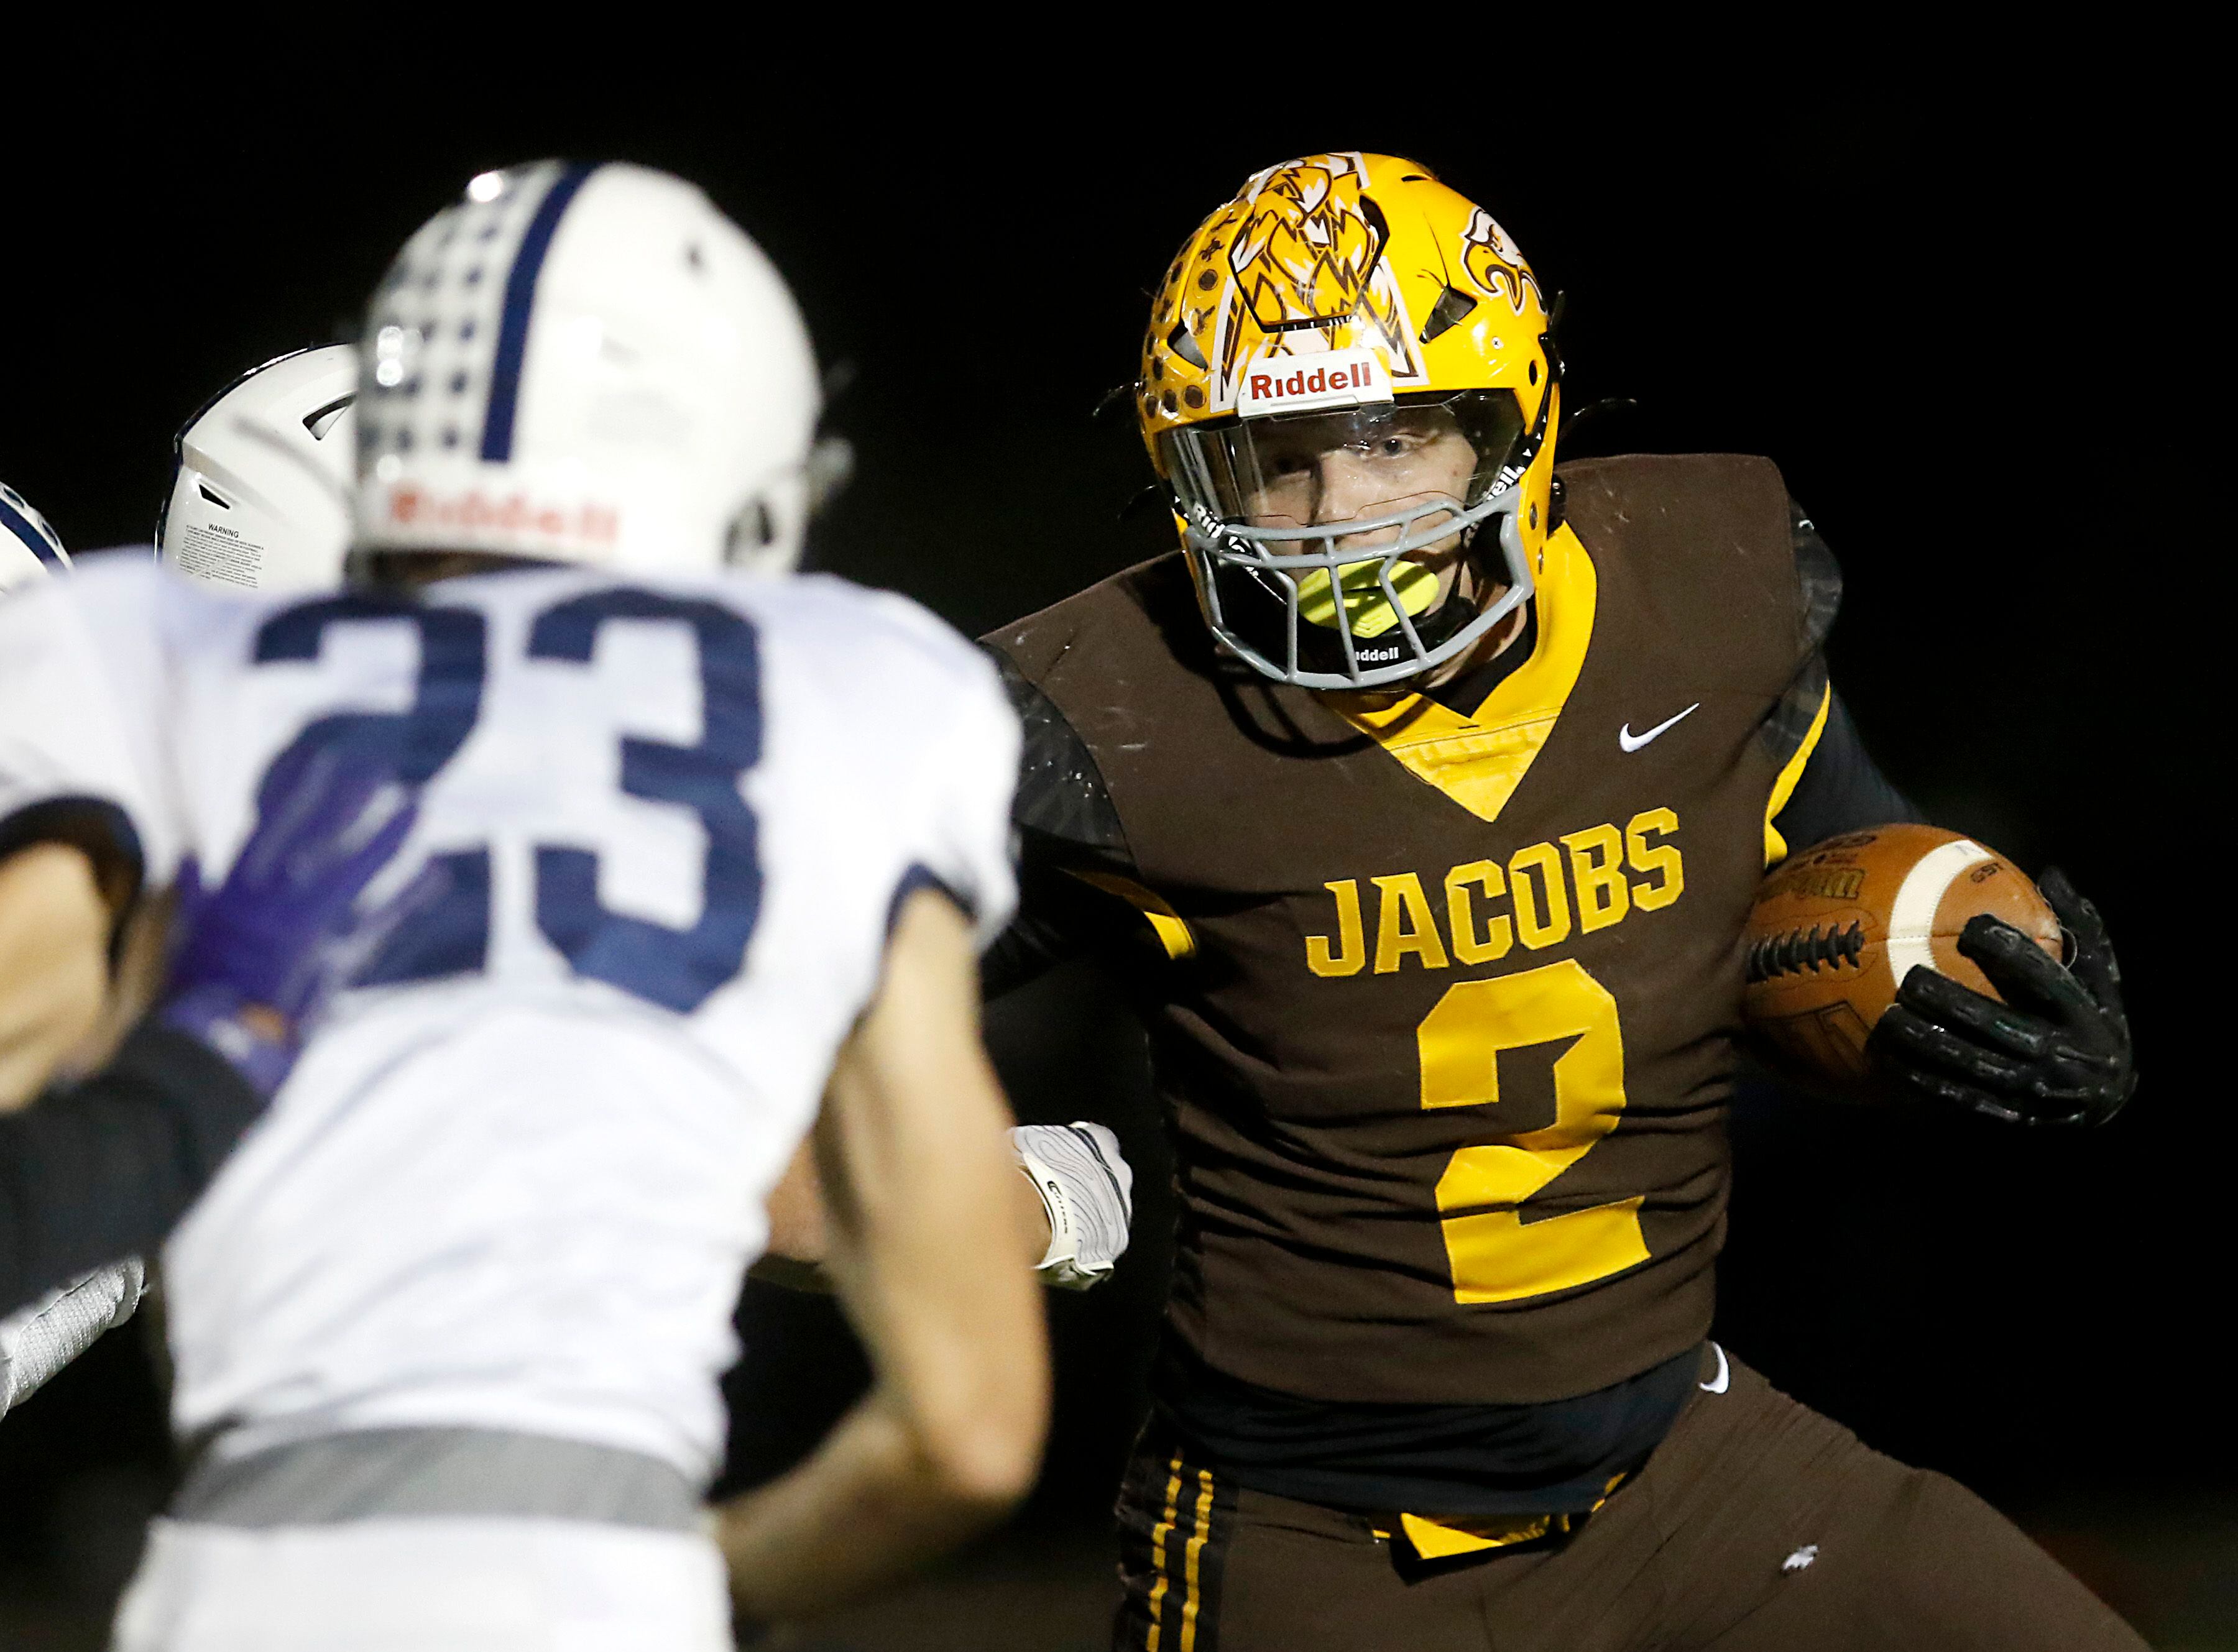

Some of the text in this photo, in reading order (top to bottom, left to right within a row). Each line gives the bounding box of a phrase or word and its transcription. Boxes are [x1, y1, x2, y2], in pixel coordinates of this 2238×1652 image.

[1251, 362, 1371, 400] Riddell
[208, 523, 239, 538] WARNING
[1355, 647, 1399, 661] iddell
[254, 587, 765, 1017] 23
[1306, 807, 1685, 978] JACOBS
[1417, 958, 1651, 1305] 2
